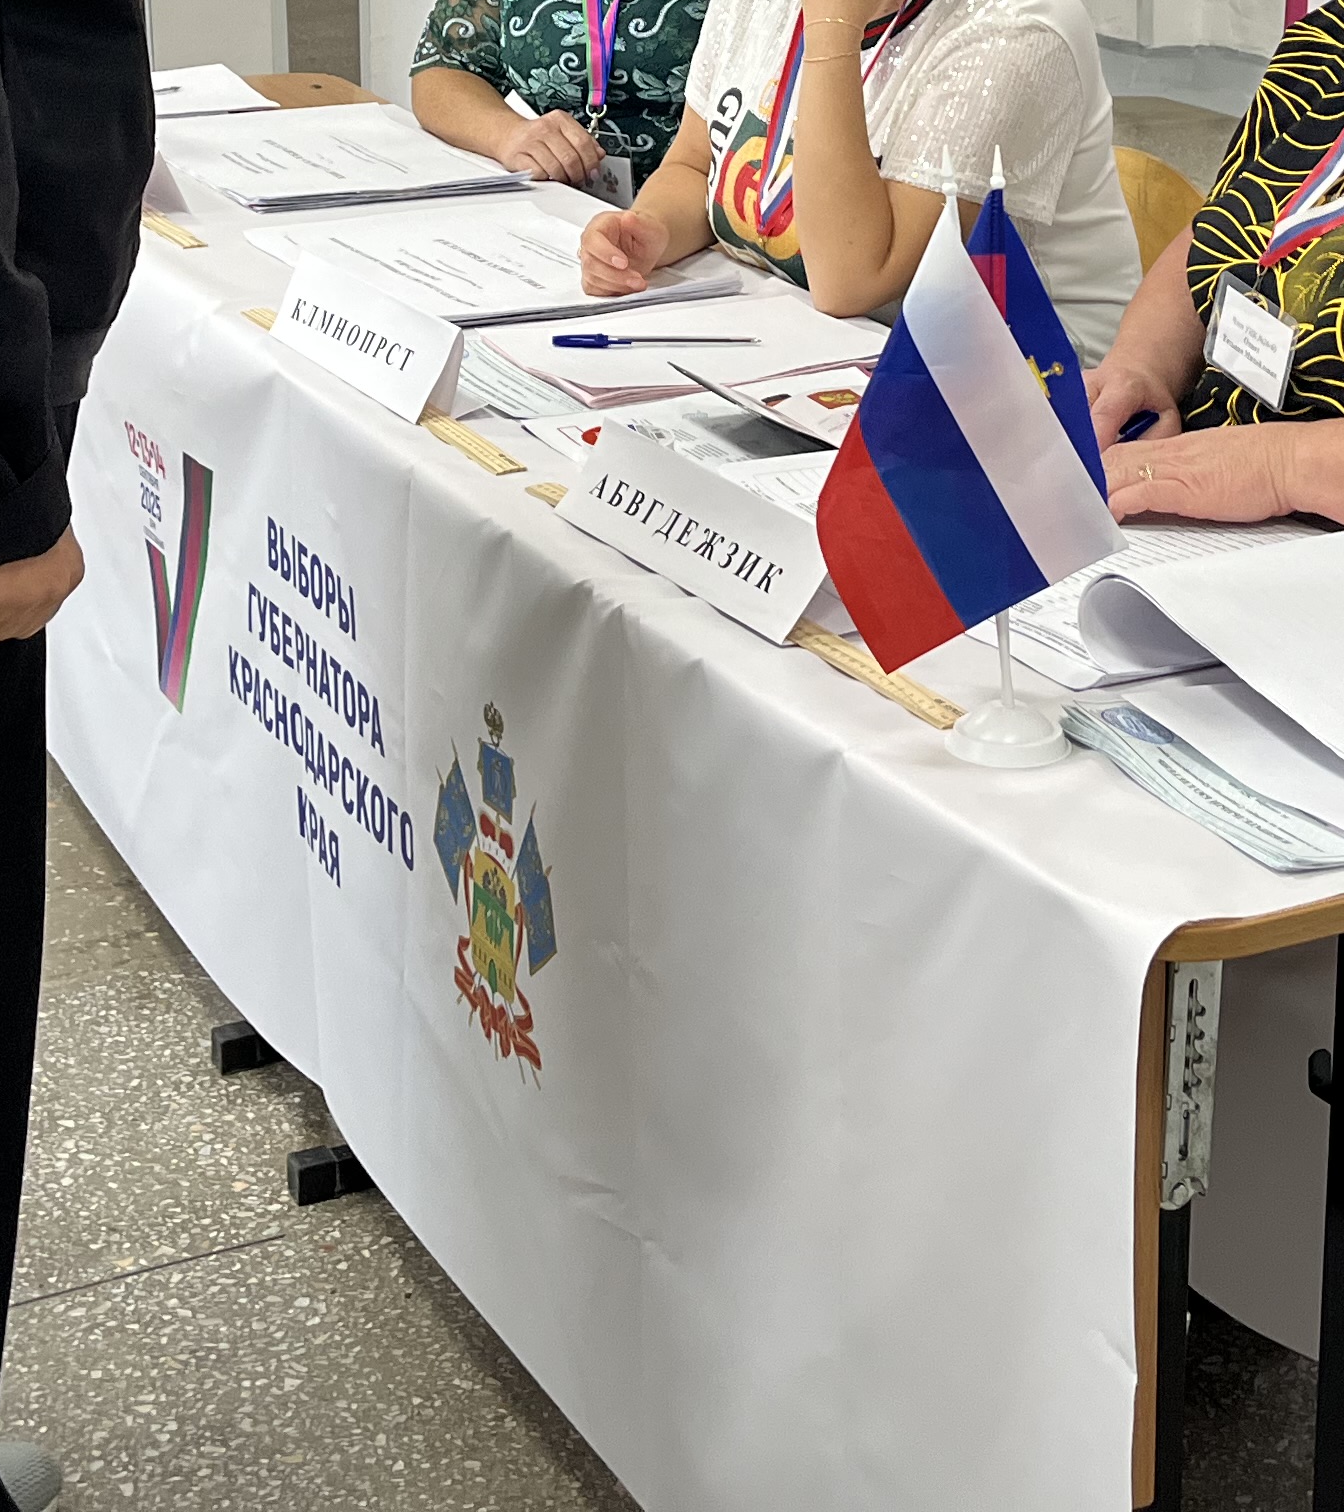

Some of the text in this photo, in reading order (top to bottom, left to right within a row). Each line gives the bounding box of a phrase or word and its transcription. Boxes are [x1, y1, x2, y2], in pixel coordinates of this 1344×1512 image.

[289, 297, 417, 373] КЛМНОПРСТ
[140, 482, 162, 522] 2025
[589, 472, 785, 596] АБВГДЕЖЗИК
[266, 515, 357, 641] ВЫБОРЫ
[246, 581, 386, 759] ГУБЕРНАТОРА
[226, 645, 416, 872] КРАСНОДАРСКОГО
[296, 785, 342, 888] КРАЯ
